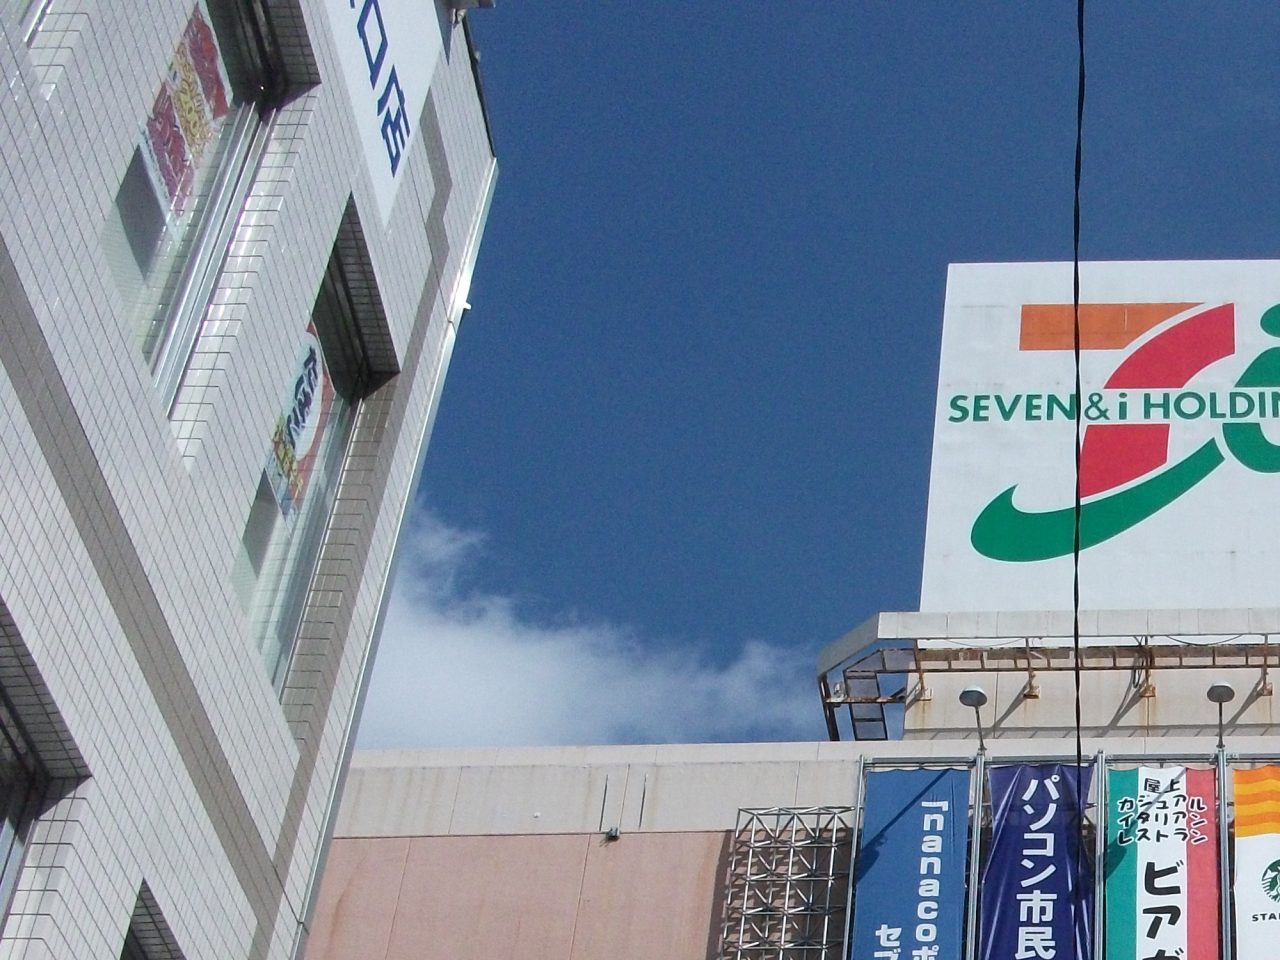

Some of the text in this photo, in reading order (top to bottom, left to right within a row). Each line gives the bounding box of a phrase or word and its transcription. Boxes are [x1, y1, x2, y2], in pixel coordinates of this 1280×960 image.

[1144, 777, 1180, 794] 屋上
[1118, 794, 1206, 812] カジュアル
[1118, 811, 1206, 828] イタリアン
[1118, 828, 1206, 845] レストラン
